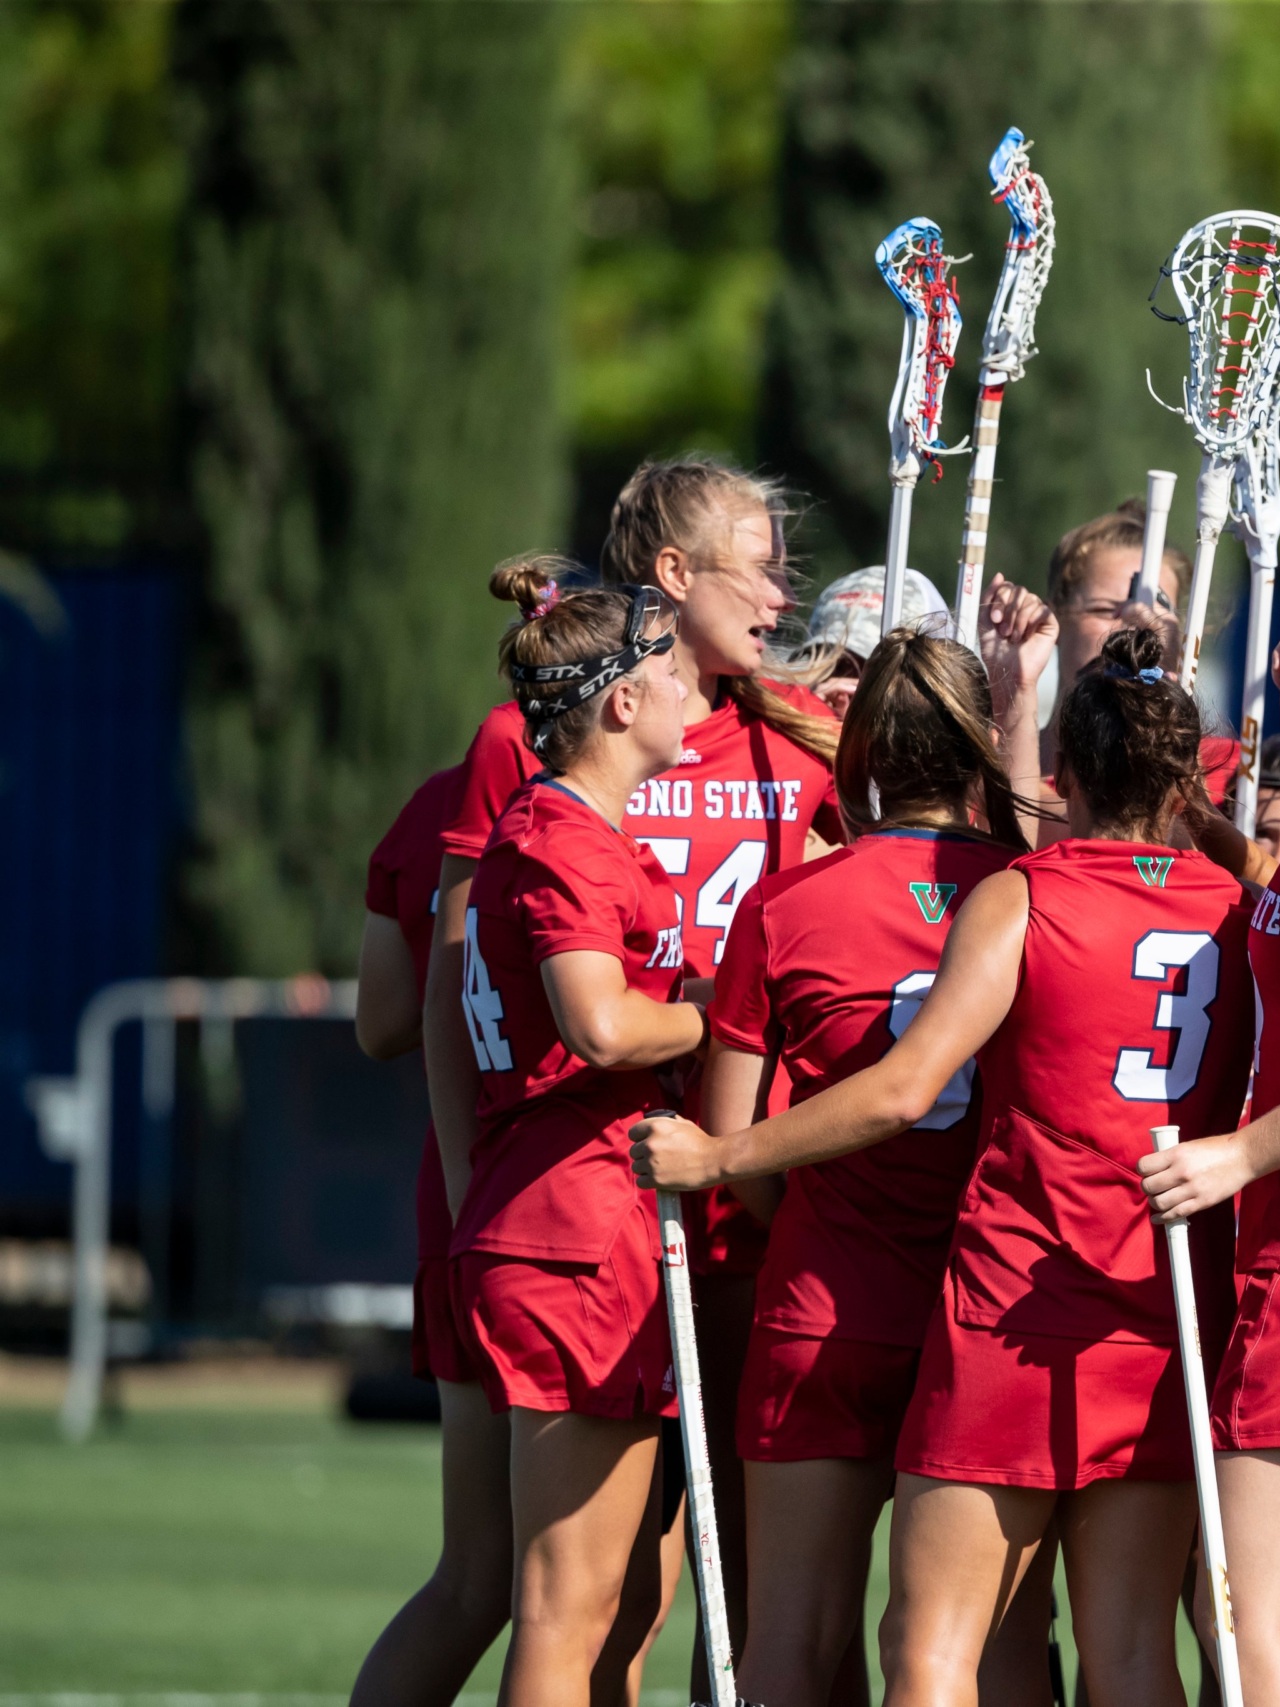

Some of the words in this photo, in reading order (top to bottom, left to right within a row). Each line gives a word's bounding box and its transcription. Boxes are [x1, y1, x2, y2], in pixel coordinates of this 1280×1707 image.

[535, 663, 586, 681] STX
[578, 661, 625, 700] STX
[626, 779, 694, 818] SNO
[703, 780, 801, 822] STATE
[1132, 855, 1175, 888] V
[908, 882, 958, 924] V
[1111, 928, 1221, 1103] 3
